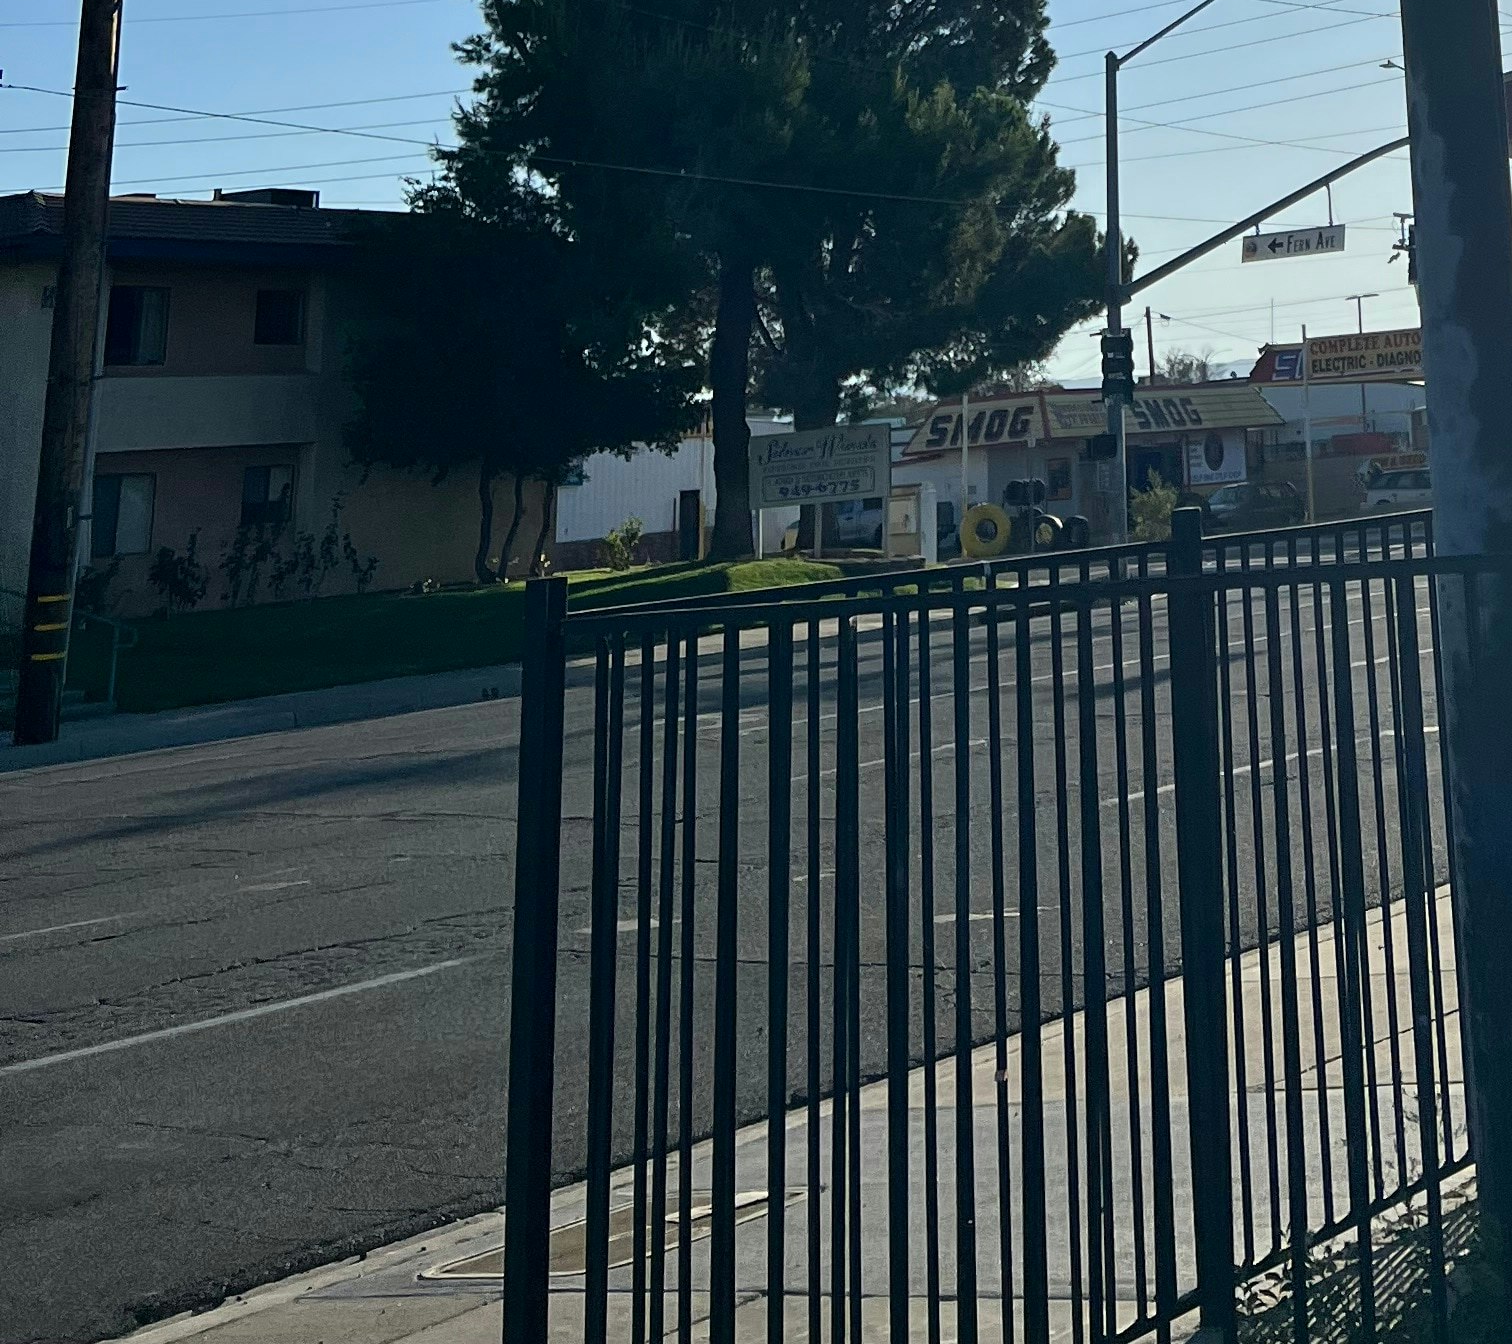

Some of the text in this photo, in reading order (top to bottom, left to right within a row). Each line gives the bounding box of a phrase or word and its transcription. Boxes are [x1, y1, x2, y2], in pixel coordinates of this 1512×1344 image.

[1310, 330, 1422, 356] COMPLETE AUTO
[1311, 354, 1367, 374] ELECTRIC
[1376, 349, 1422, 368] DIAGNO
[925, 405, 1035, 449] SMOG
[1129, 397, 1203, 431] SMOG
